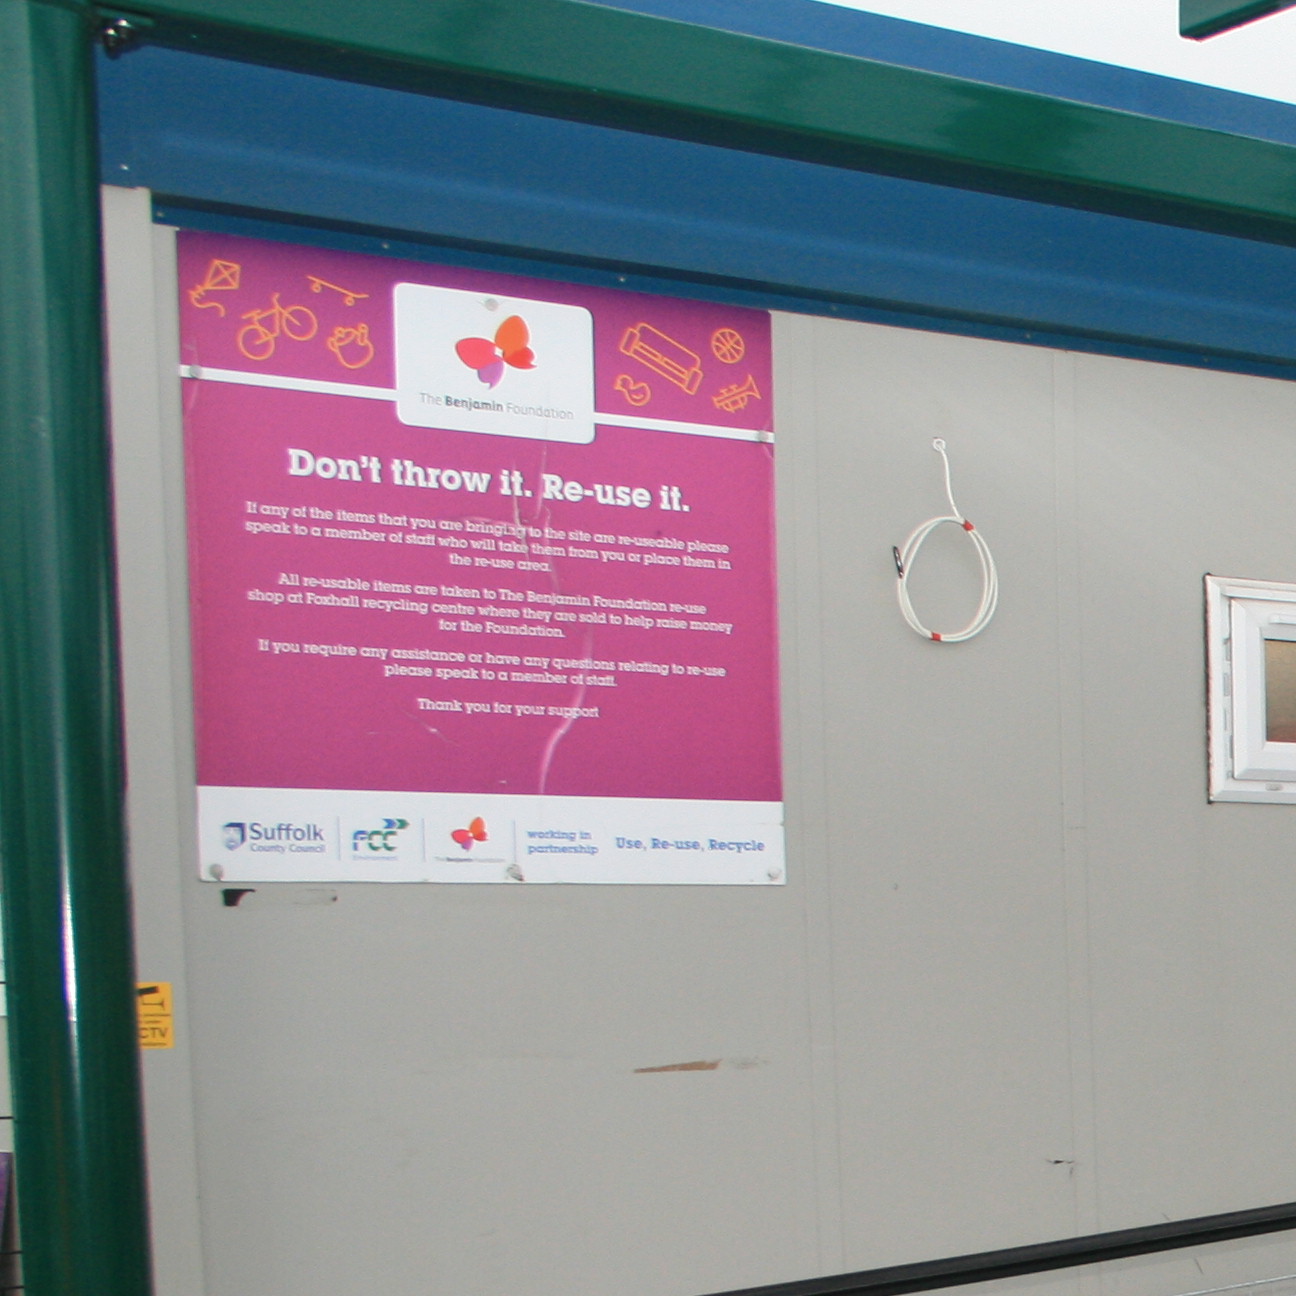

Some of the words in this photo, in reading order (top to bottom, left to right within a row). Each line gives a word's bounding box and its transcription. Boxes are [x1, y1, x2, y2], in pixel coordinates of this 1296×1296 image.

[420, 393, 442, 406] The
[445, 396, 503, 411] Benjamin
[506, 402, 574, 420] Foundation
[288, 449, 380, 482] Don't
[390, 458, 490, 492] throw
[500, 469, 531, 497] it.
[541, 473, 651, 508] Re-use
[659, 485, 688, 511] it.
[246, 501, 257, 513] If
[259, 504, 289, 518] any
[291, 506, 306, 517] of
[309, 507, 333, 519] the
[336, 509, 375, 523] items
[377, 513, 407, 526] that
[409, 517, 436, 529] you
[438, 520, 463, 530] are
[466, 520, 525, 538] bringing
[528, 527, 542, 537] to
[543, 526, 565, 539] the
[568, 529, 591, 541] site
[593, 533, 615, 543] are
[617, 535, 684, 549] re-useable
[687, 540, 728, 553] please
[245, 521, 290, 534] speak
[293, 523, 308, 535] to
[310, 526, 321, 536] a
[324, 527, 386, 541] member
[388, 531, 402, 543] of
[405, 533, 435, 545] staff
[437, 535, 468, 548] who
[469, 538, 495, 550] will
[497, 539, 528, 553] take
[530, 543, 565, 556] them
[568, 545, 598, 558] from
[599, 550, 625, 562] you
[627, 552, 640, 562] or
[643, 552, 680, 565] place
[682, 555, 715, 568] them
[717, 558, 730, 569] in
[448, 552, 472, 565] the
[473, 557, 515, 569] re-use
[278, 572, 299, 585] All
[302, 577, 370, 590] re-usable
[372, 580, 411, 593] items
[413, 584, 438, 595] are
[440, 585, 480, 598] taken
[482, 588, 496, 599] to
[498, 588, 524, 601] The
[526, 590, 591, 606] Benjamin
[593, 595, 667, 611] Foundation
[669, 603, 706, 614] re-use
[247, 588, 284, 604] shop
[286, 592, 303, 603] at
[305, 592, 359, 607] Foxhall
[362, 598, 428, 614] recycling
[430, 602, 475, 615] centre
[477, 604, 520, 618] where
[521, 607, 552, 622] they
[554, 611, 576, 621] are
[578, 611, 606, 623] sold
[608, 613, 622, 624] to
[624, 614, 654, 628] help
[656, 617, 687, 629] raise
[689, 620, 732, 634] money
[438, 618, 457, 630] for
[459, 619, 482, 632] the
[258, 638, 269, 650] If
[271, 641, 300, 654] you
[303, 643, 357, 656] require
[359, 647, 388, 660] any
[390, 648, 465, 662] assistance
[467, 653, 482, 663] or
[485, 652, 520, 665] have
[522, 656, 550, 669] any
[552, 658, 615, 670] questions
[618, 660, 669, 675] relating
[671, 663, 684, 674] to
[686, 665, 725, 676] re-use
[383, 663, 432, 676] please
[435, 667, 479, 679] speak
[480, 668, 495, 680] to
[497, 671, 508, 680] a
[510, 671, 567, 683] member
[570, 673, 584, 685] of
[417, 697, 462, 711] Thank
[463, 702, 490, 713] you
[493, 701, 512, 713] for
[514, 704, 545, 716] your
[547, 704, 600, 718] support
[249, 822, 324, 841] Suffolk
[352, 830, 397, 851] FCC
[526, 829, 576, 841] working
[579, 831, 591, 839] in
[248, 842, 285, 853] County
[288, 843, 324, 852] Council
[527, 843, 599, 856] partnership
[616, 837, 645, 851] Use,
[652, 837, 703, 852] Re-use,
[709, 838, 766, 854] Recycle
[138, 1027, 169, 1039] CTV
